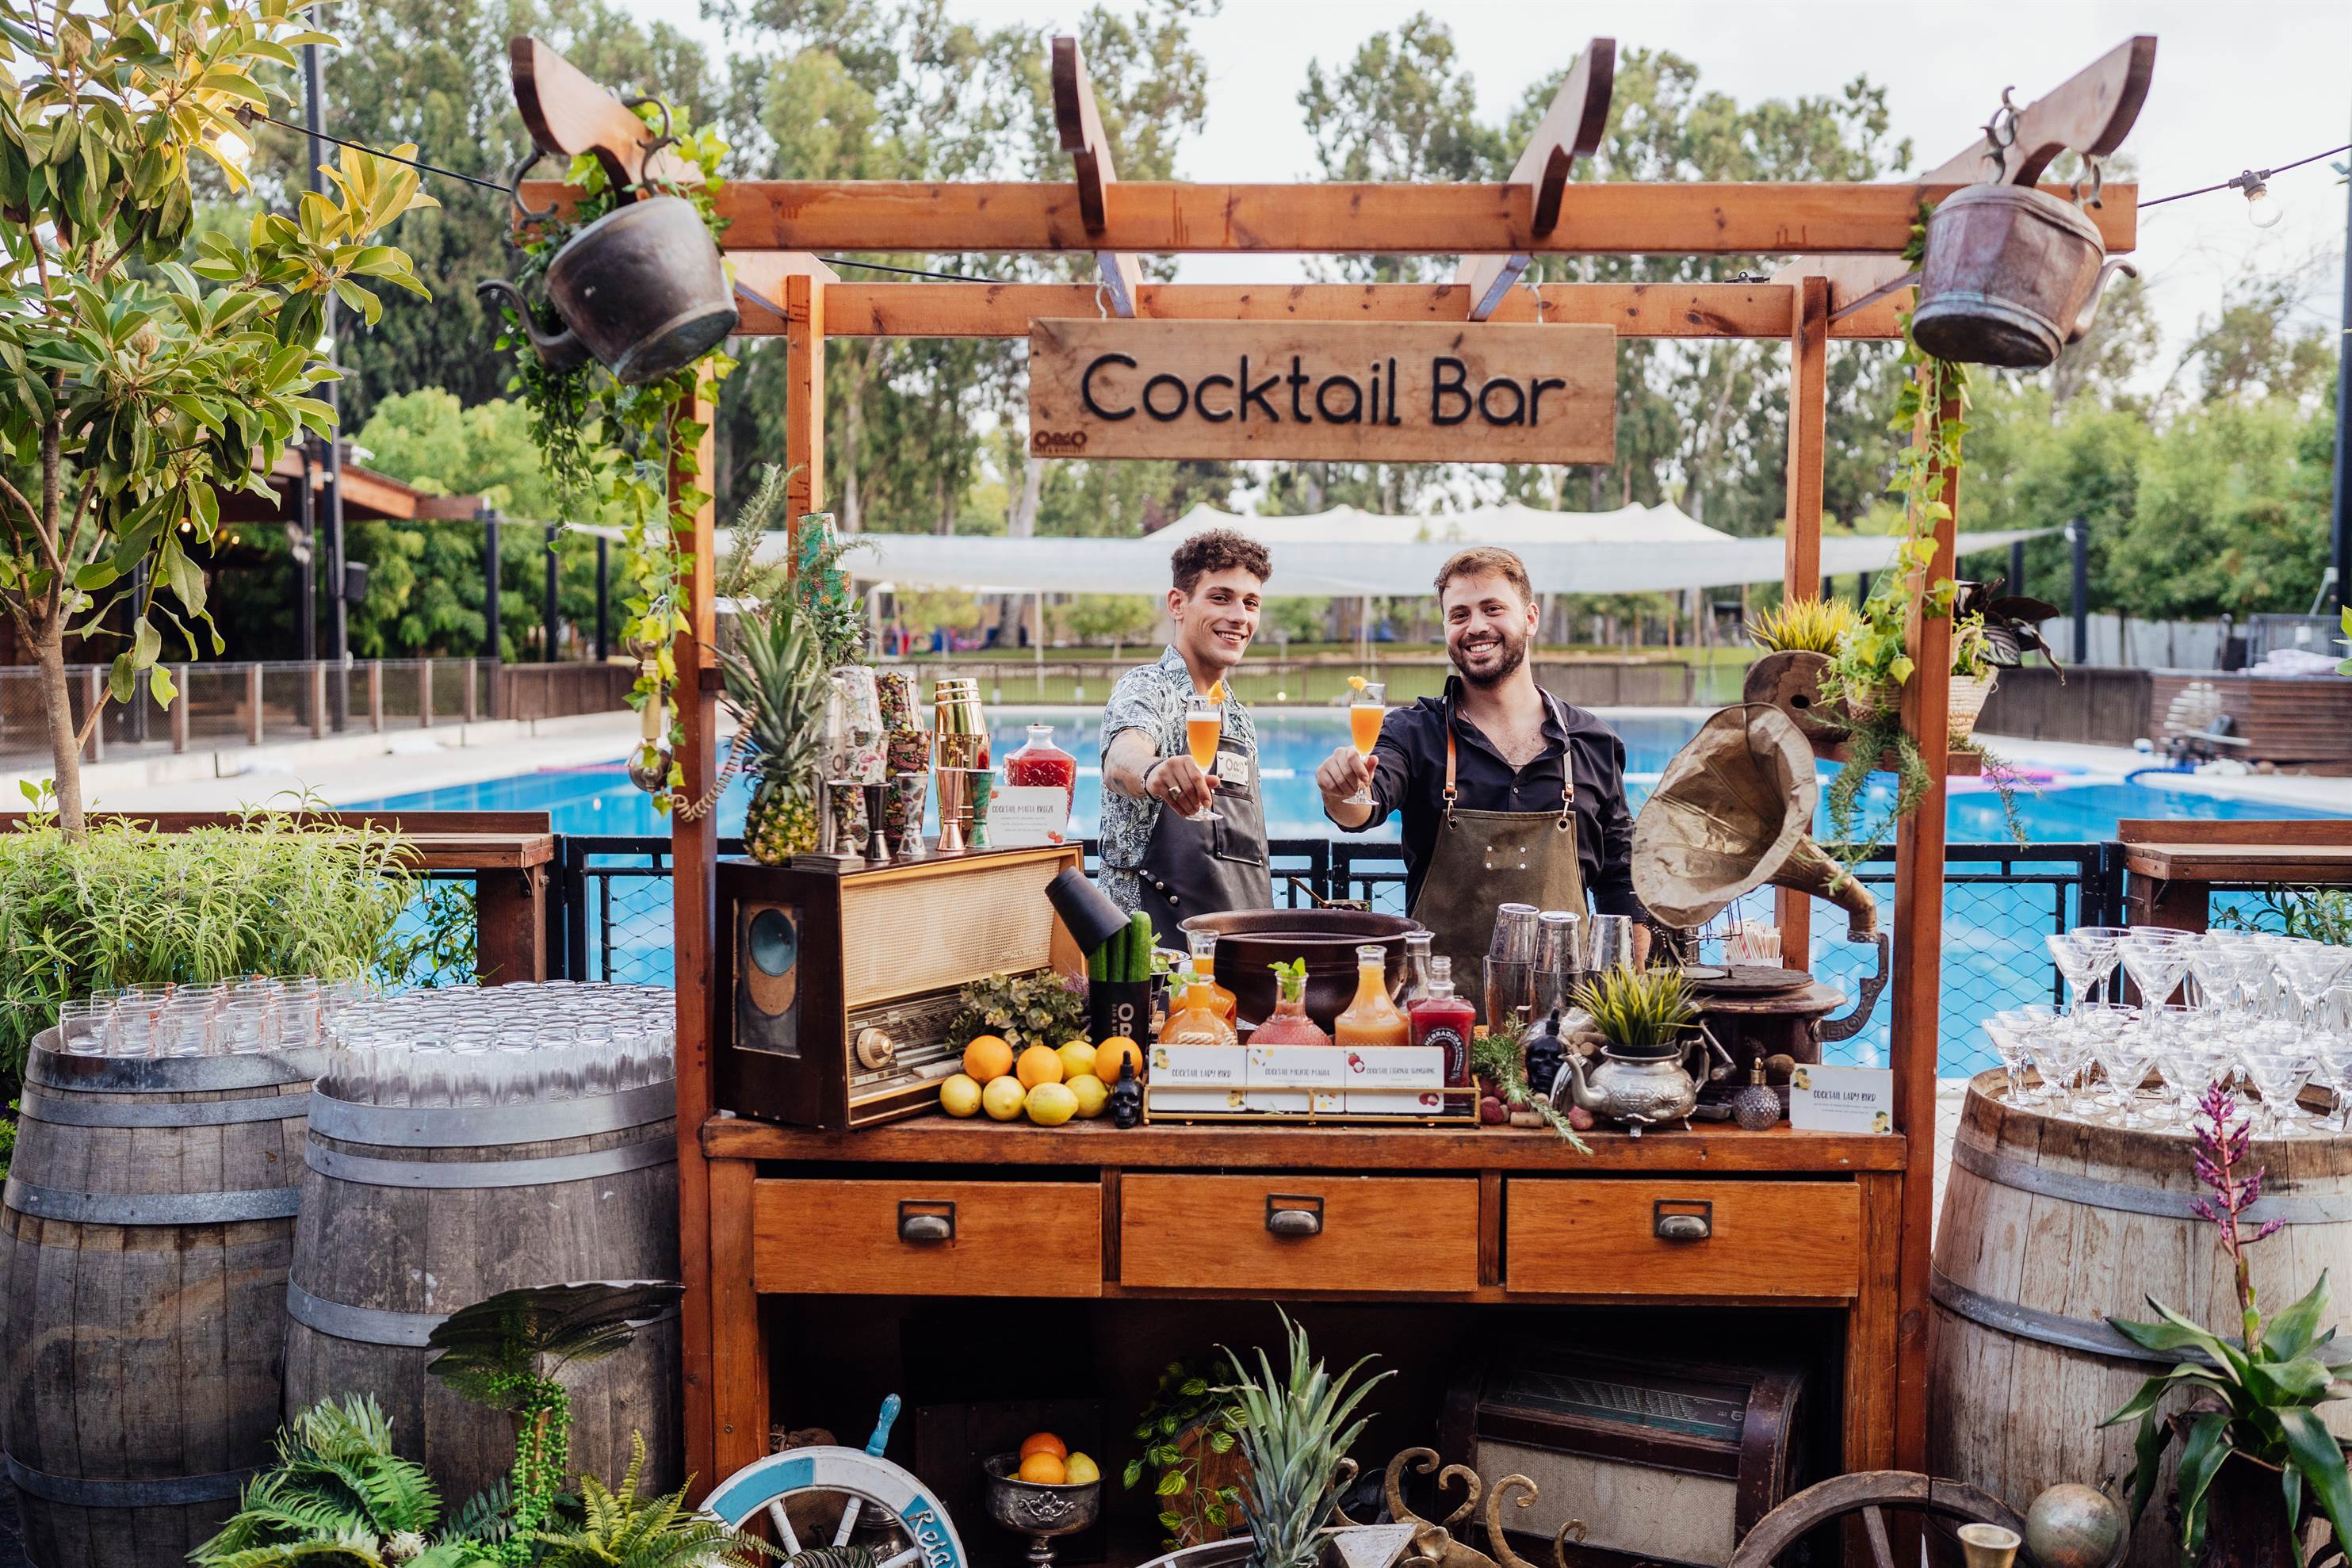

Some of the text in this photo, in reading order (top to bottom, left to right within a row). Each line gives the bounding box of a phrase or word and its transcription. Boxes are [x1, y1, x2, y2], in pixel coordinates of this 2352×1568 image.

[1080, 353, 1566, 426] Cocktail Bar
[1424, 1030, 1462, 1047] HERRADURA
[1172, 1069, 1198, 1078] COCKTAIL
[1813, 1090, 1876, 1102] COCKTAIL LADY BIRD
